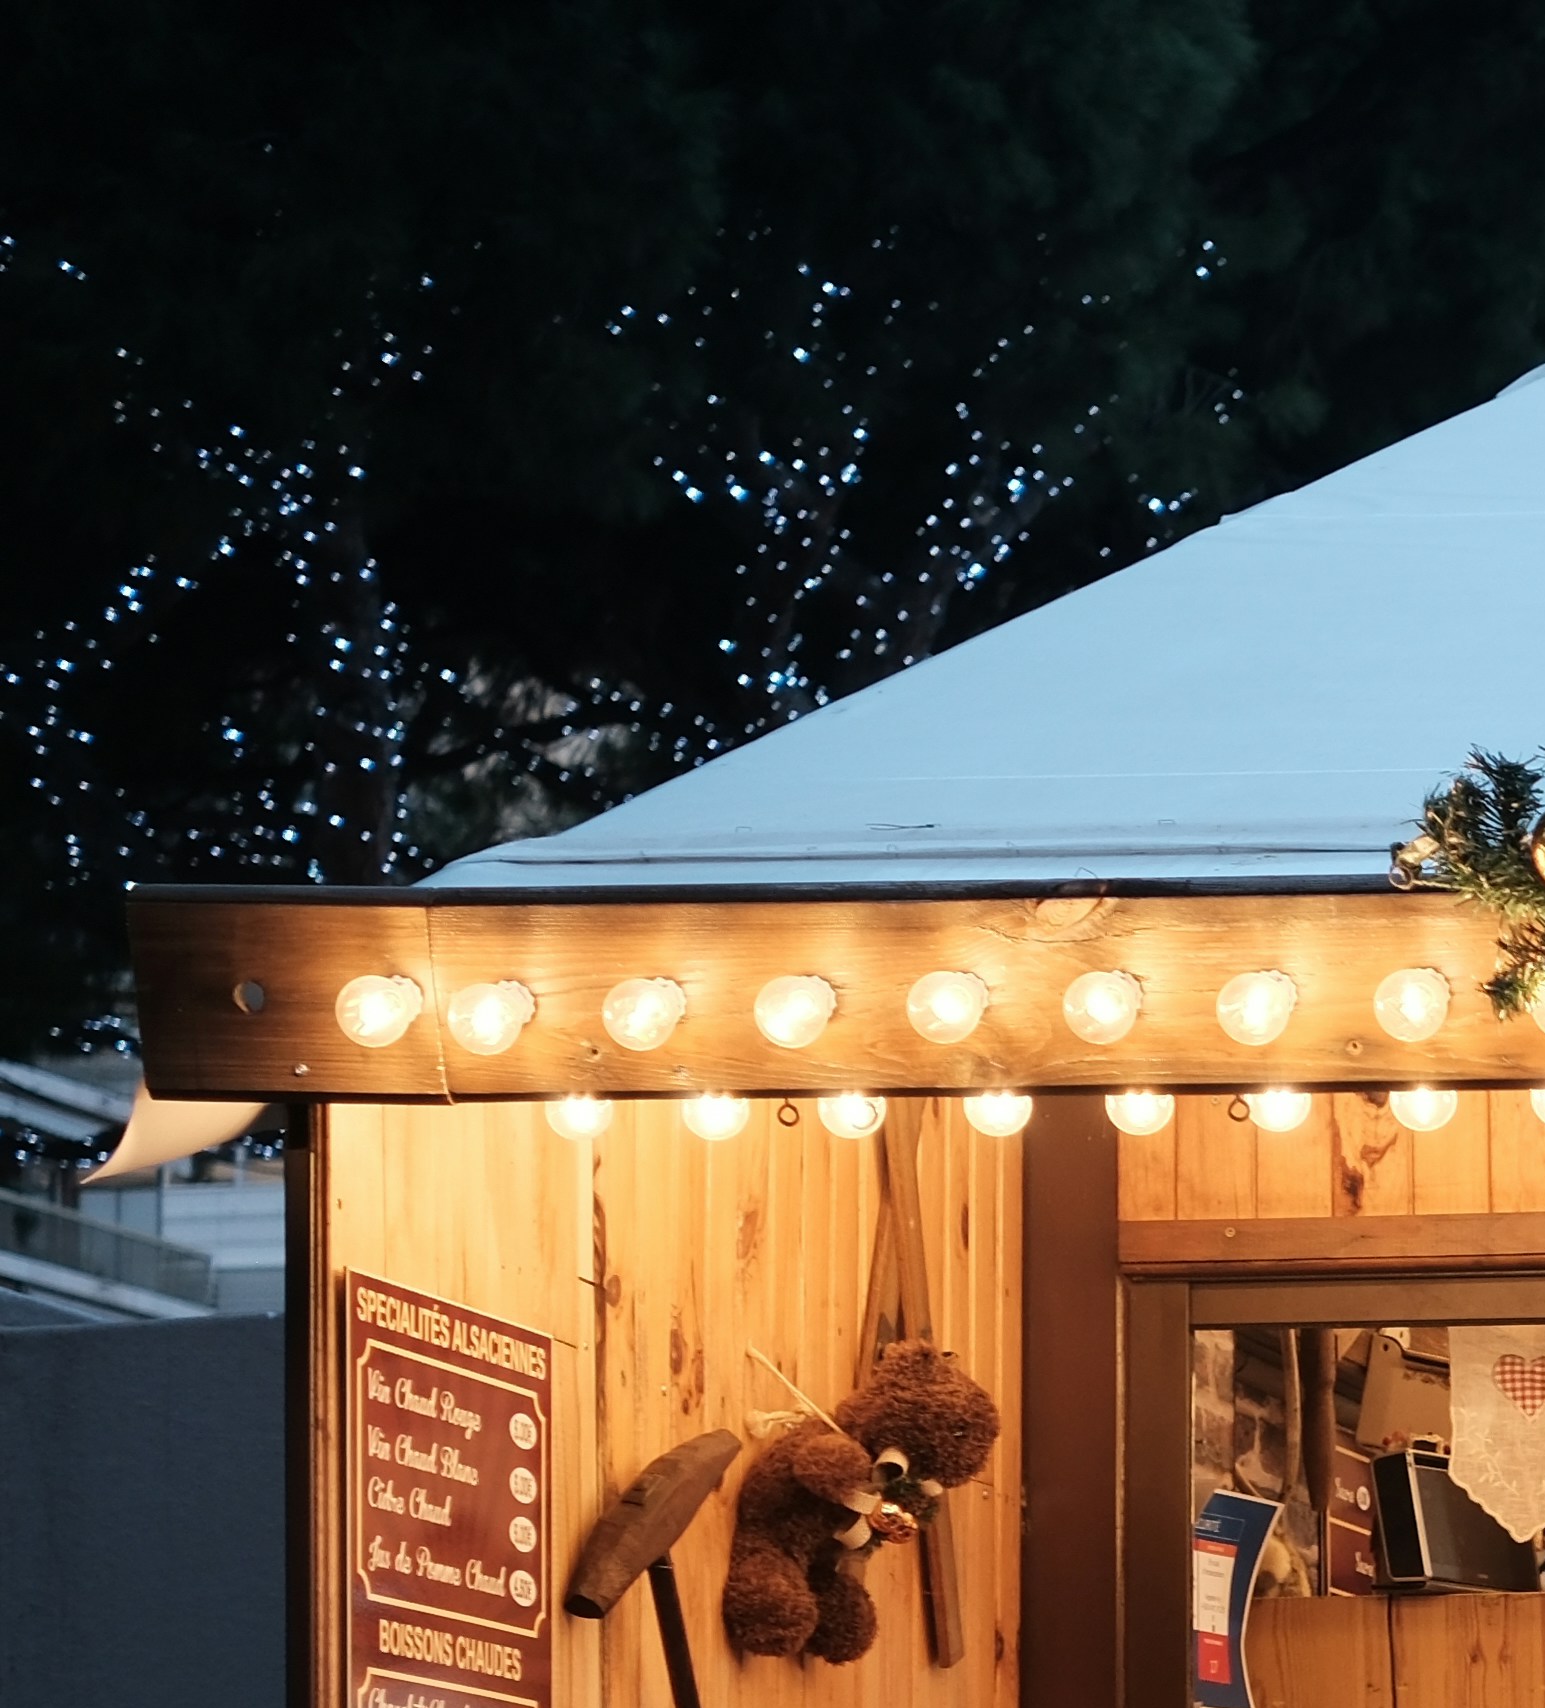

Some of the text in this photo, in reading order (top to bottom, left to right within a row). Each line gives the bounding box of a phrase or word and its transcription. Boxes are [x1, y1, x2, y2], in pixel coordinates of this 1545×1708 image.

[356, 1286, 546, 1381] SPECIALITÉS ALSACIENNES
[367, 1367, 391, 1404] Vin
[395, 1377, 438, 1418] Chaud
[440, 1391, 482, 1440] Rouge
[367, 1424, 391, 1461] Vin
[395, 1434, 438, 1474] Chaud
[440, 1447, 479, 1486] Blanc
[368, 1476, 406, 1515] Cidre
[409, 1487, 452, 1527] Chaud
[368, 1535, 391, 1571] Jus
[395, 1541, 412, 1575] de
[416, 1546, 461, 1586] Pomme
[465, 1559, 507, 1597] Chaud
[379, 1618, 522, 1681] BOISSONS CHAUDES
